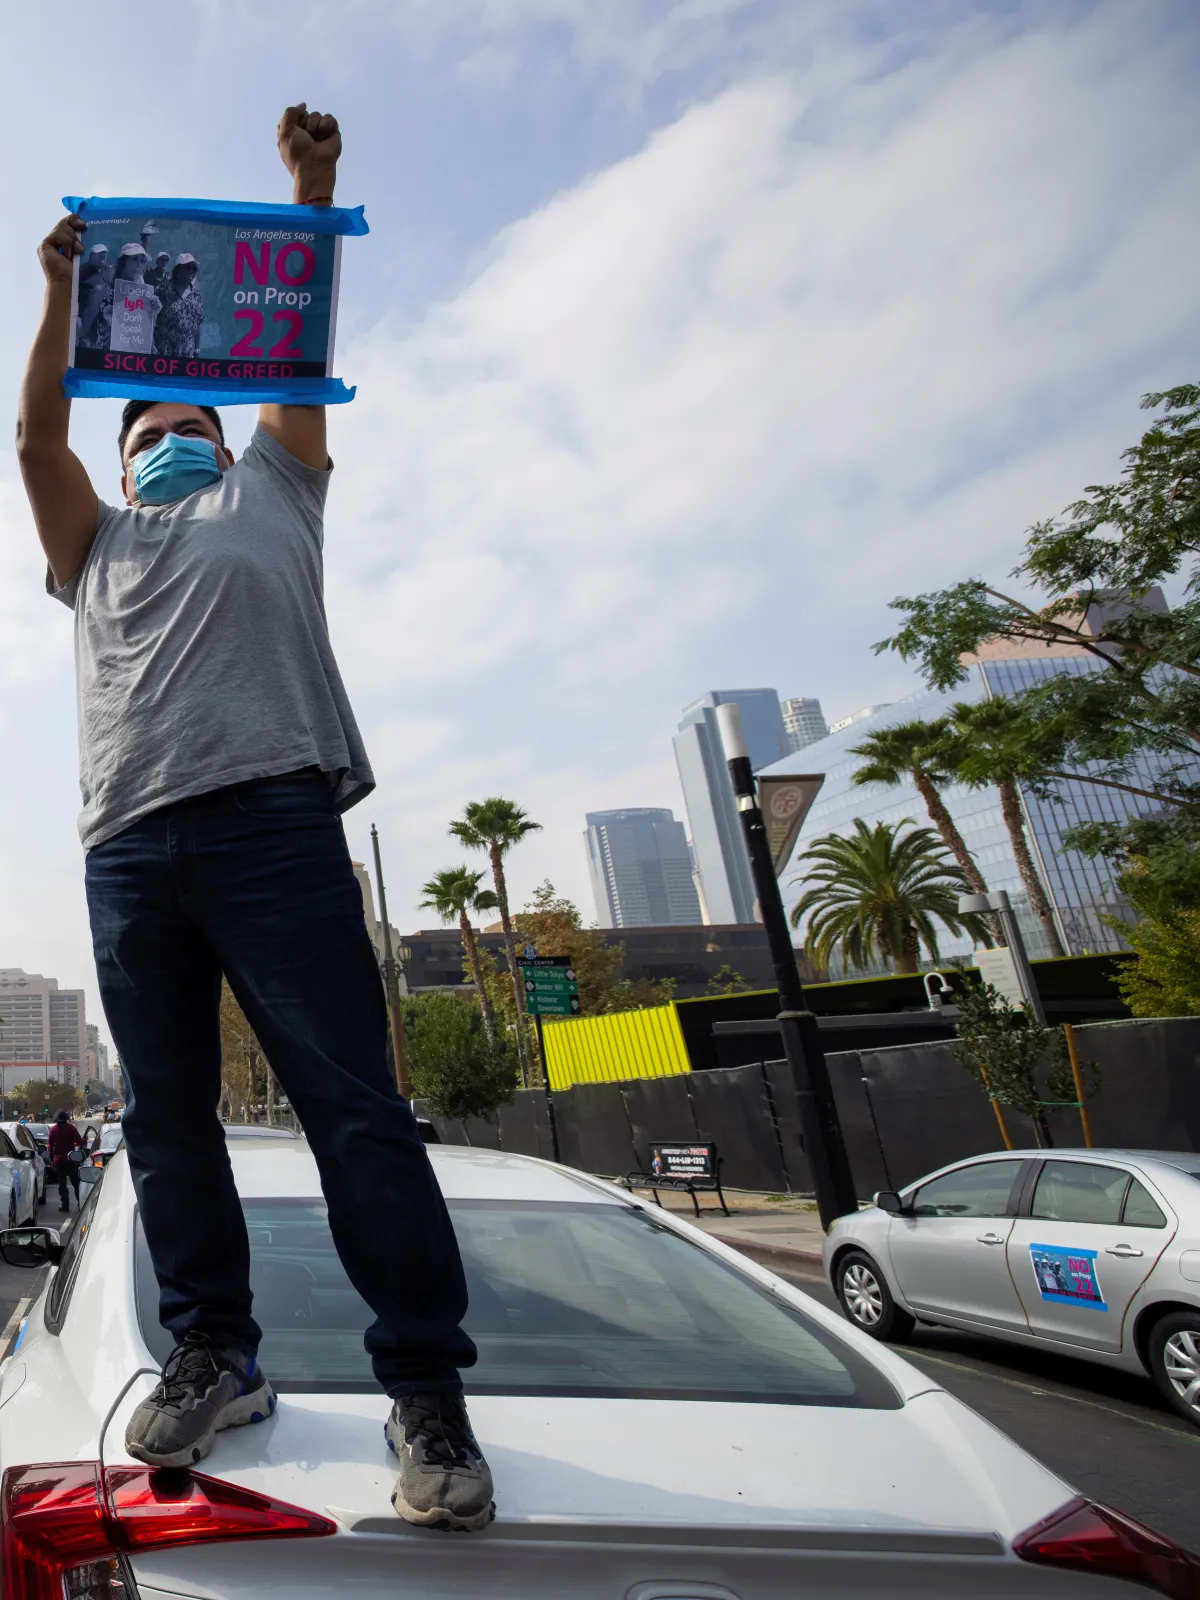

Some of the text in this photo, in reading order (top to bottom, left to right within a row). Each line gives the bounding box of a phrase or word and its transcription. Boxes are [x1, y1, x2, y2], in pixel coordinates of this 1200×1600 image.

[235, 229, 315, 242] Los Angeles says
[233, 241, 315, 286] NO
[120, 283, 145, 296] Uber
[123, 296, 145, 311] lyft
[233, 287, 312, 309] on Prop
[123, 312, 142, 322] Don't
[120, 322, 143, 335] Speak
[229, 308, 304, 358] 22
[120, 333, 145, 345] For Me
[104, 353, 294, 379] SICK OF GIG GREED
[549, 970, 565, 979] Tokyo
[536, 996, 558, 1004] Historic
[1068, 1259, 1090, 1274] NO
[1079, 1272, 1092, 1280] Prop
[1073, 1277, 1095, 1295] 22
